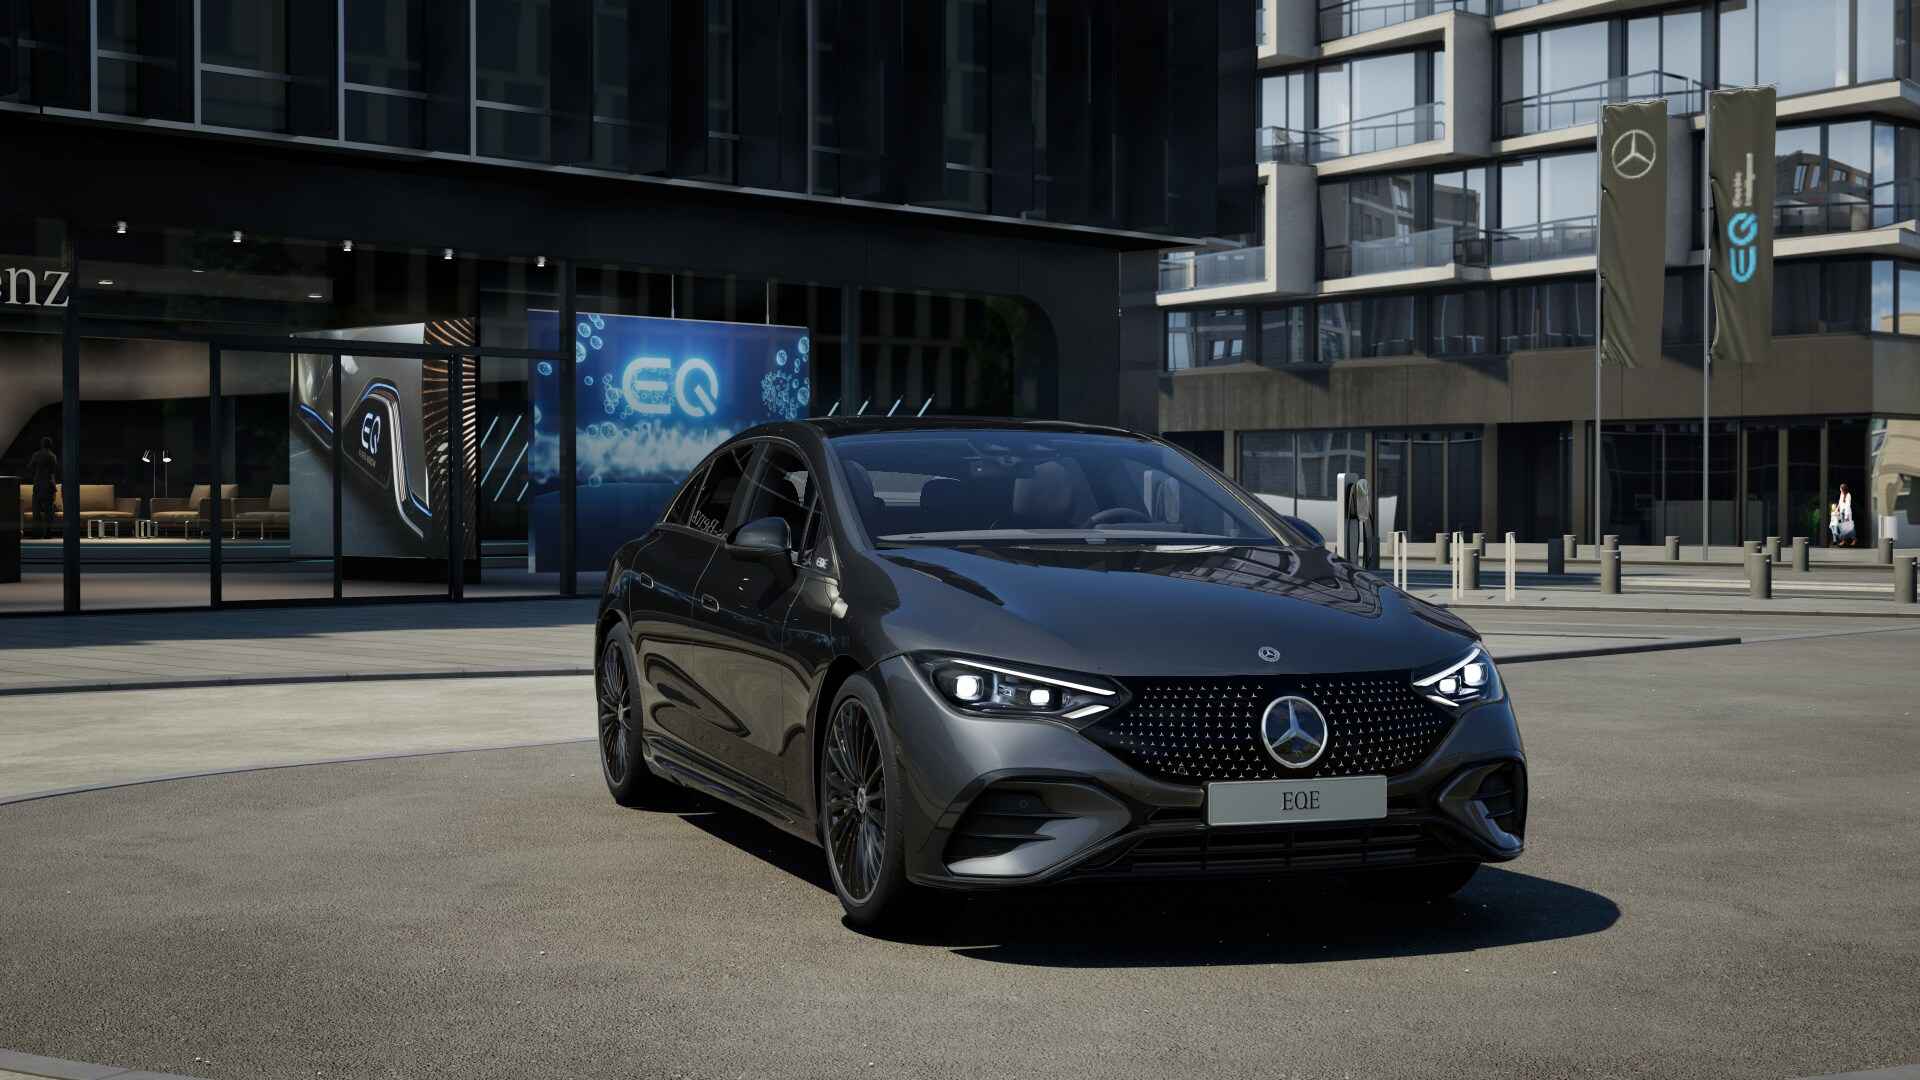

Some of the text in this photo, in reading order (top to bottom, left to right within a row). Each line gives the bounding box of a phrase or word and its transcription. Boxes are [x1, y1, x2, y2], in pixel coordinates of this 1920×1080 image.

[1728, 212, 1758, 283] EQ
[0, 266, 70, 308] nz
[623, 356, 719, 417] EQ
[361, 412, 381, 455] EQ
[1281, 790, 1321, 811] EQE
